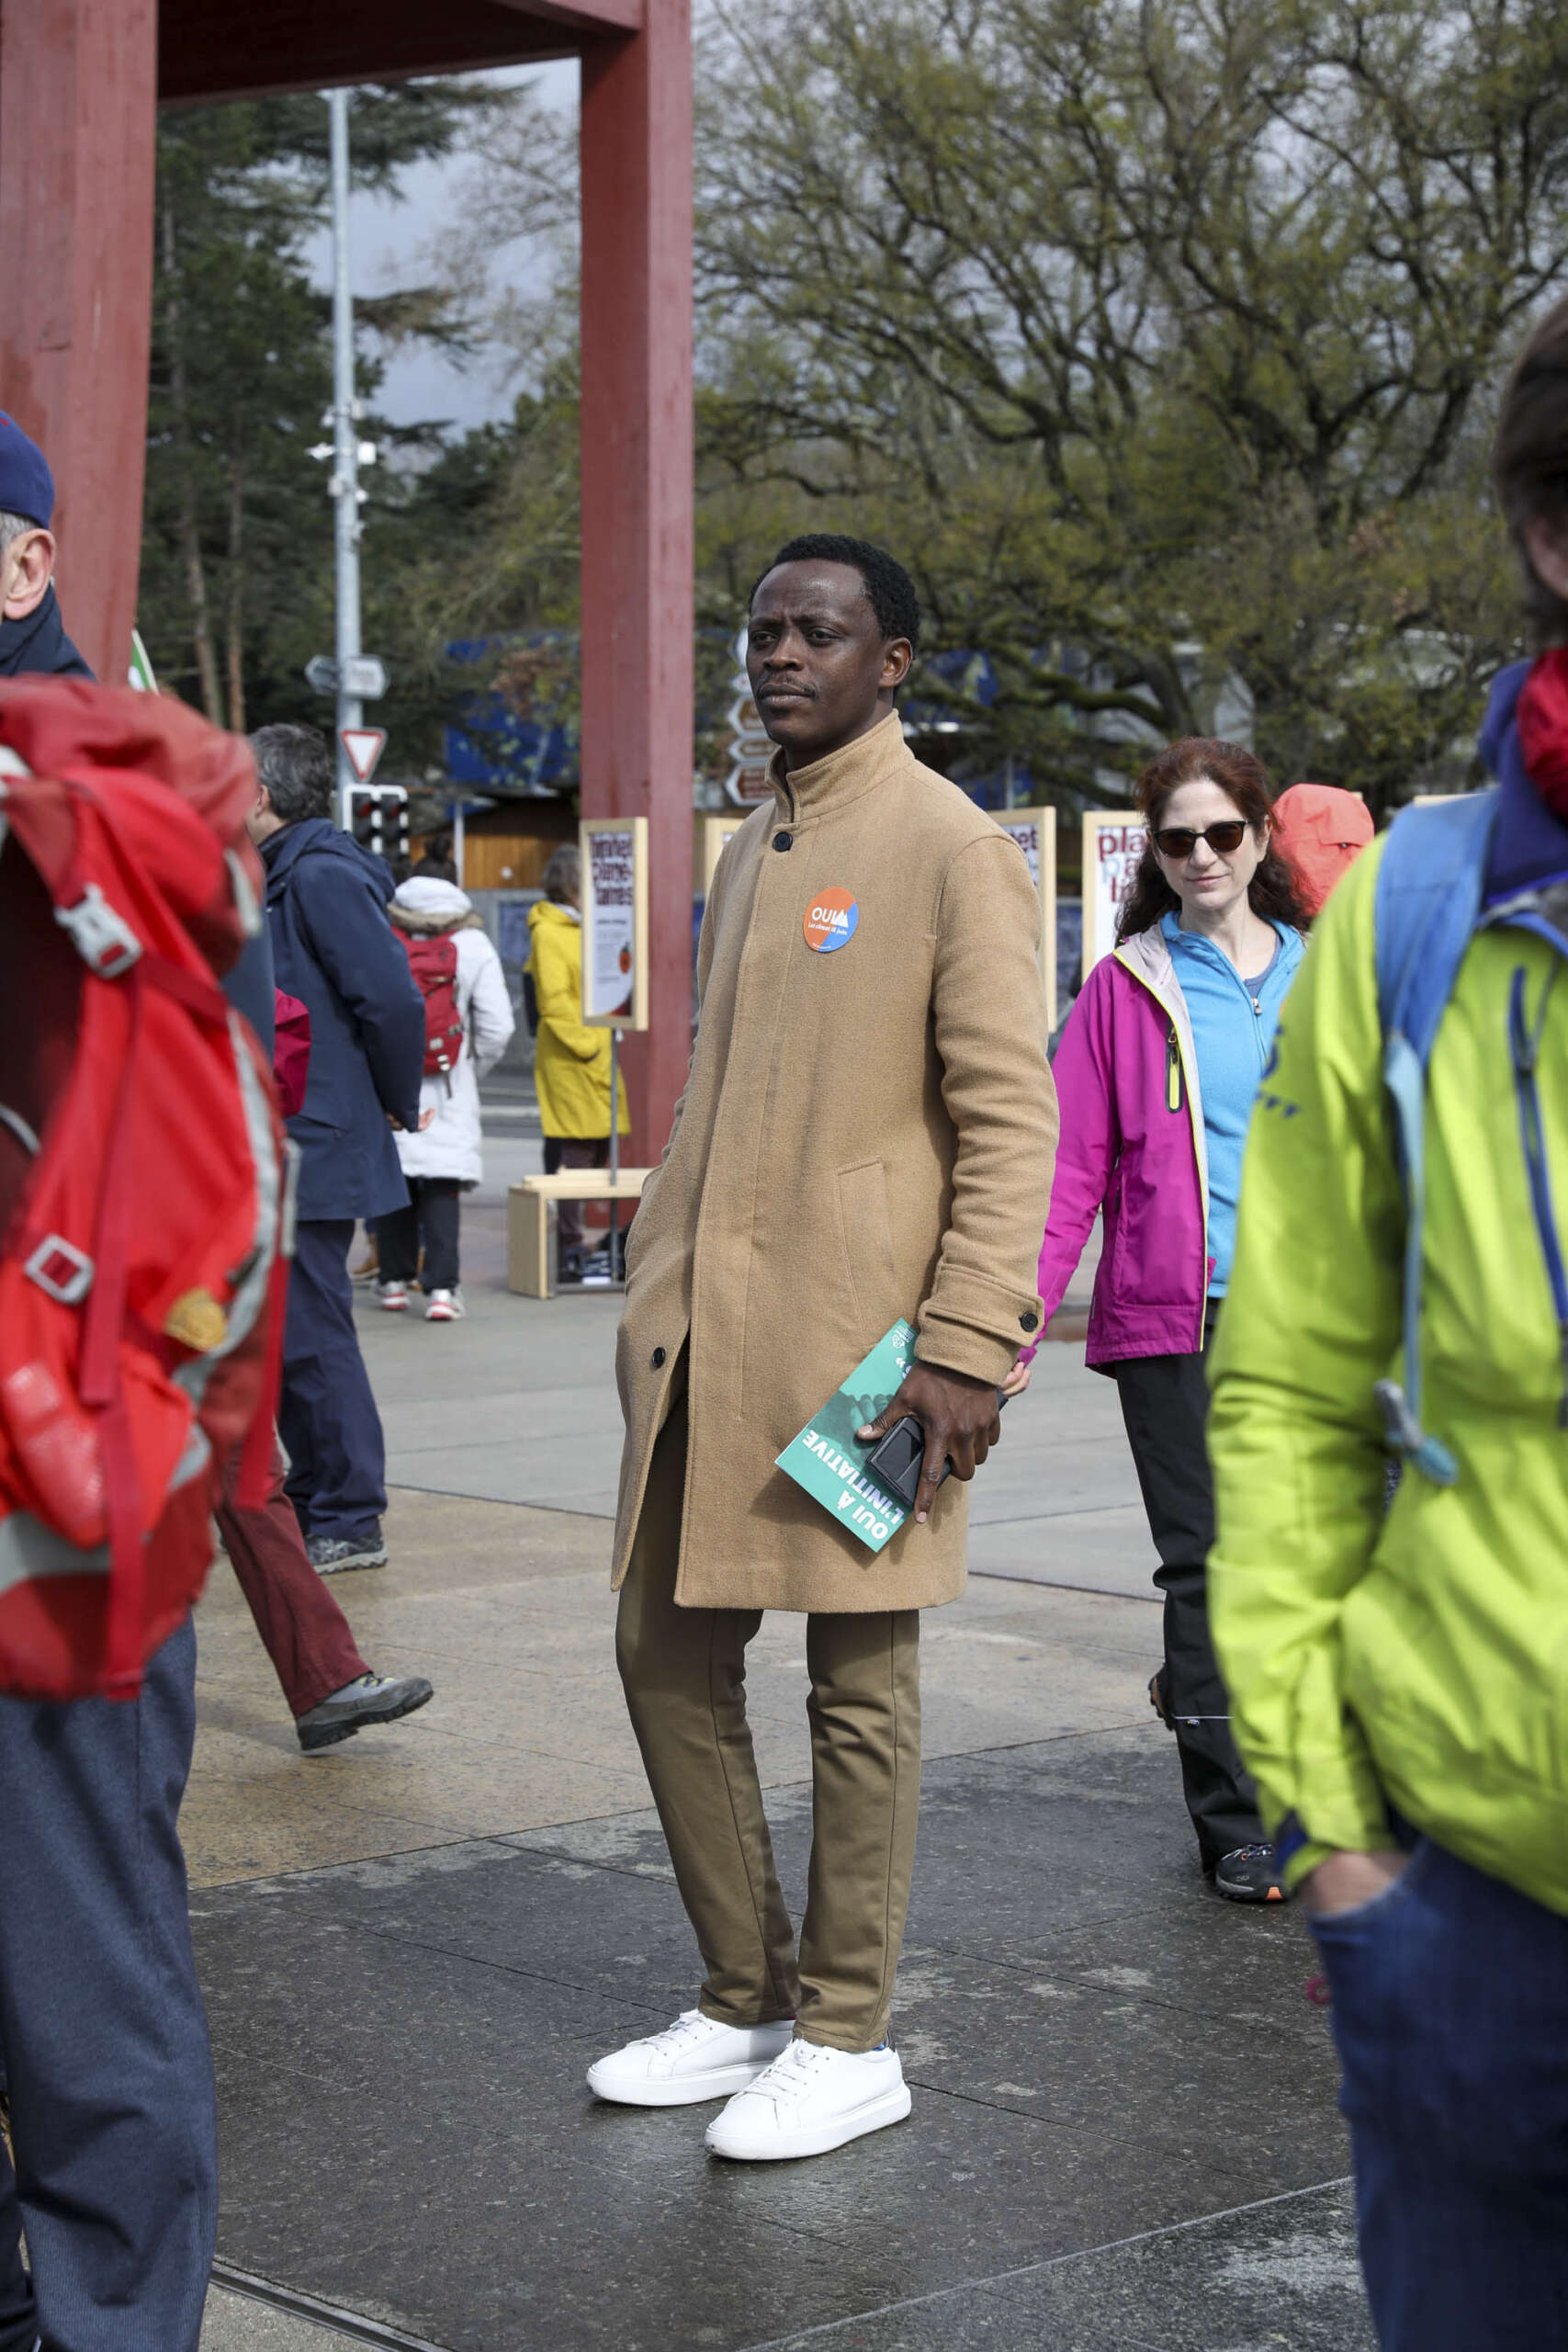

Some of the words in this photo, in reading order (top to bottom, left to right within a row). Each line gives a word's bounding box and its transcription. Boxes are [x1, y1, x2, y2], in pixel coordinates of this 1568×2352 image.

[1099, 827, 1145, 862] pla
[812, 907, 837, 924] OUI
[802, 1430, 905, 1526] L'INITIATIVE
[837, 1489, 856, 1510] À
[852, 1510, 889, 1540] OUI
